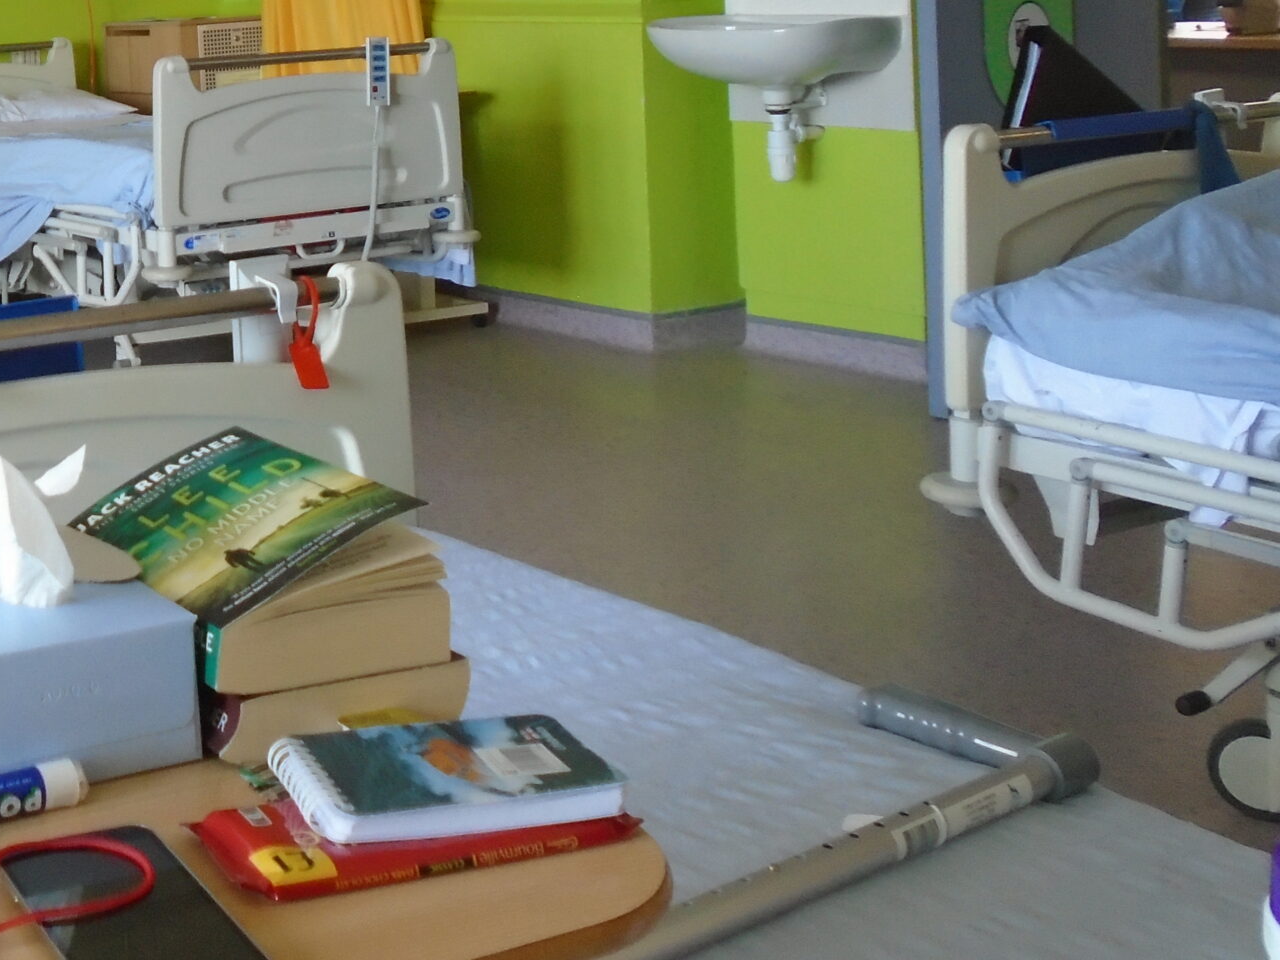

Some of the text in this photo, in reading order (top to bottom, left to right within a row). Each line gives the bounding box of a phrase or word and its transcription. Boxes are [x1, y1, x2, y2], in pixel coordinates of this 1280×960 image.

[75, 433, 241, 533] JACK REACHER
[127, 457, 303, 567] CHILD
[137, 463, 241, 528] LEE
[167, 536, 205, 563] NO
[207, 477, 297, 535] MIDDLE
[214, 501, 281, 547] NAME
[480, 840, 545, 866] Bournville
